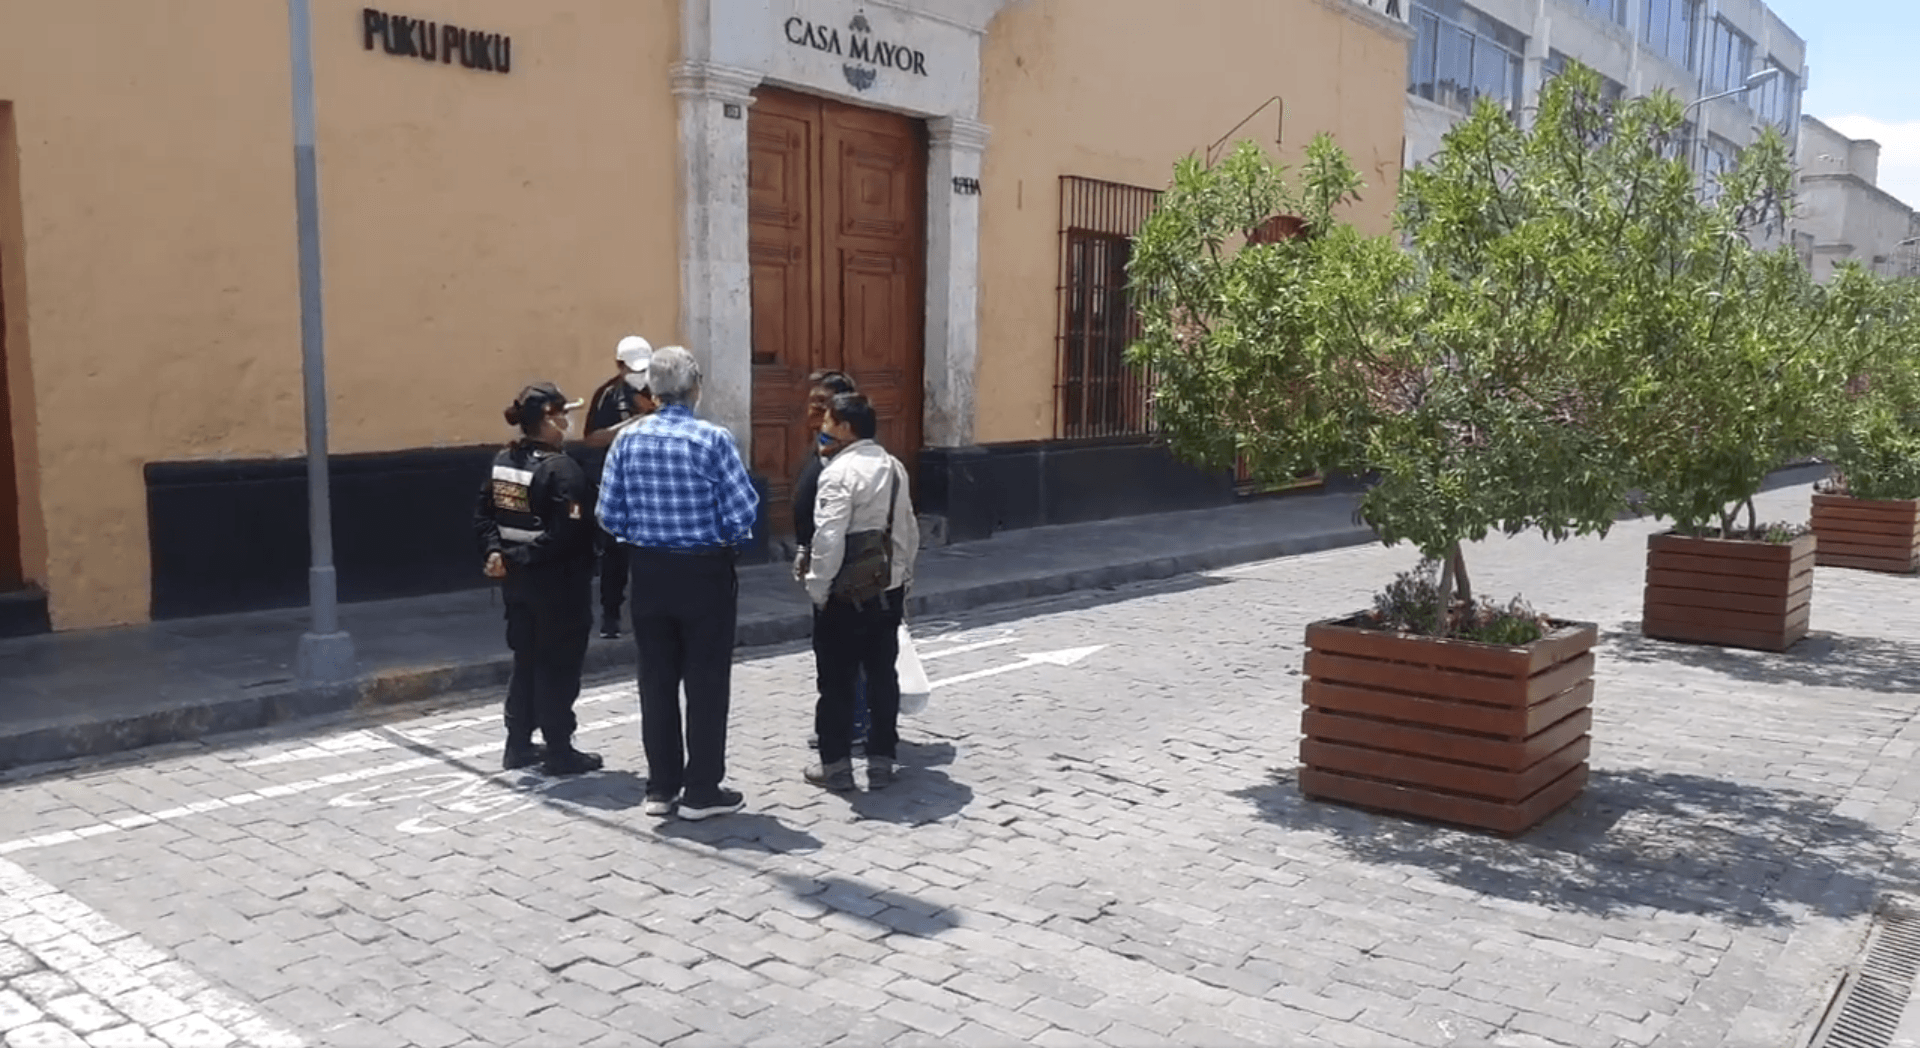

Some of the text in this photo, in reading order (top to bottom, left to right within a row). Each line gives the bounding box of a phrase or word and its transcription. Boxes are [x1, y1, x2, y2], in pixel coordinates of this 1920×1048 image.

[363, 8, 510, 73] PUKU PUKU
[785, 17, 928, 77] CASA MAYOR
